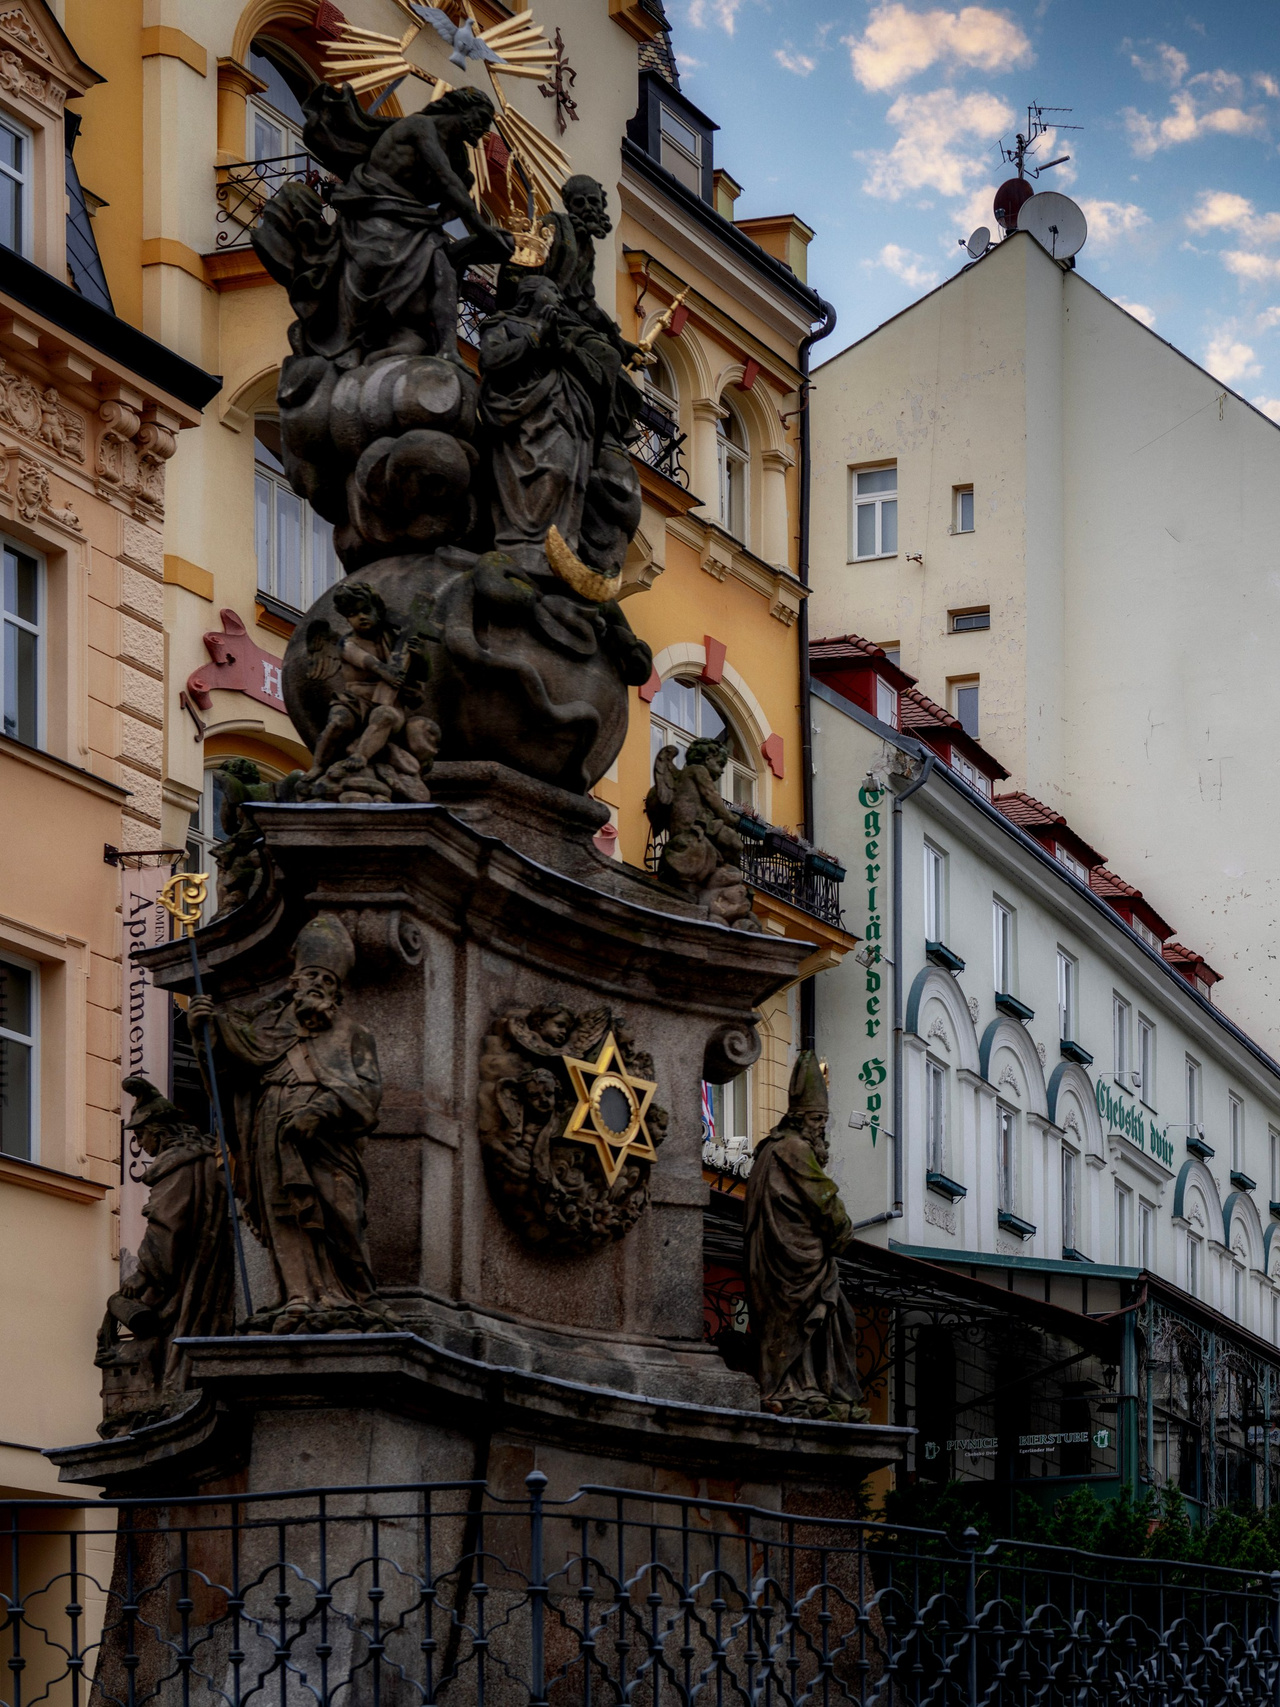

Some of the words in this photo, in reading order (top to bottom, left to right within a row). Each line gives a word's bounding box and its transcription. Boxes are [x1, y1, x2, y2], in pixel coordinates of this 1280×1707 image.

[858, 1057, 887, 1149] Hof
[1096, 1079, 1145, 1151] Chebský
[946, 1437, 999, 1451] PIVNICE
[1018, 1431, 1089, 1446] BIERSTUBE
